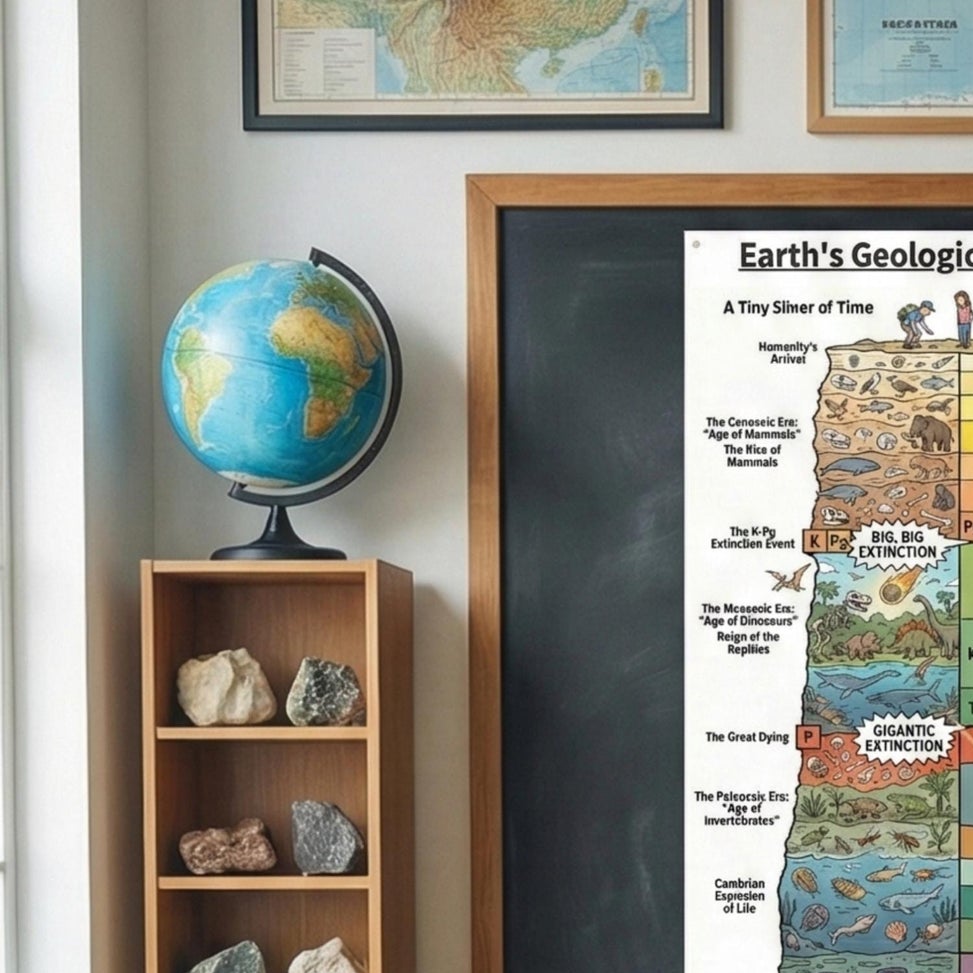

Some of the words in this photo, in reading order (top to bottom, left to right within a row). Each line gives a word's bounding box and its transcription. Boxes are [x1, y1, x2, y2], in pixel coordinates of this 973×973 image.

[739, 241, 844, 267] Earth's
[723, 300, 735, 314] A
[738, 300, 769, 317] Tiny
[818, 300, 833, 314] of
[837, 300, 874, 314] Time
[706, 416, 726, 427] The
[732, 428, 742, 439] of
[724, 444, 743, 454] The
[770, 444, 782, 454] of
[730, 526, 749, 537] The
[902, 530, 924, 543] BIG
[766, 539, 795, 549] Event
[810, 535, 820, 548] K
[859, 546, 937, 558] EXTINCTION
[702, 603, 721, 614] The
[727, 615, 738, 626] of
[717, 631, 747, 644] Reign
[762, 631, 780, 641] the
[873, 724, 935, 737] GIGANTIC
[706, 731, 725, 743] The
[727, 731, 757, 743] Great
[758, 731, 790, 744] Dying
[804, 731, 813, 743] P
[866, 739, 943, 752] EXTINCTION
[694, 791, 714, 802] The
[715, 878, 765, 889] Cambrian
